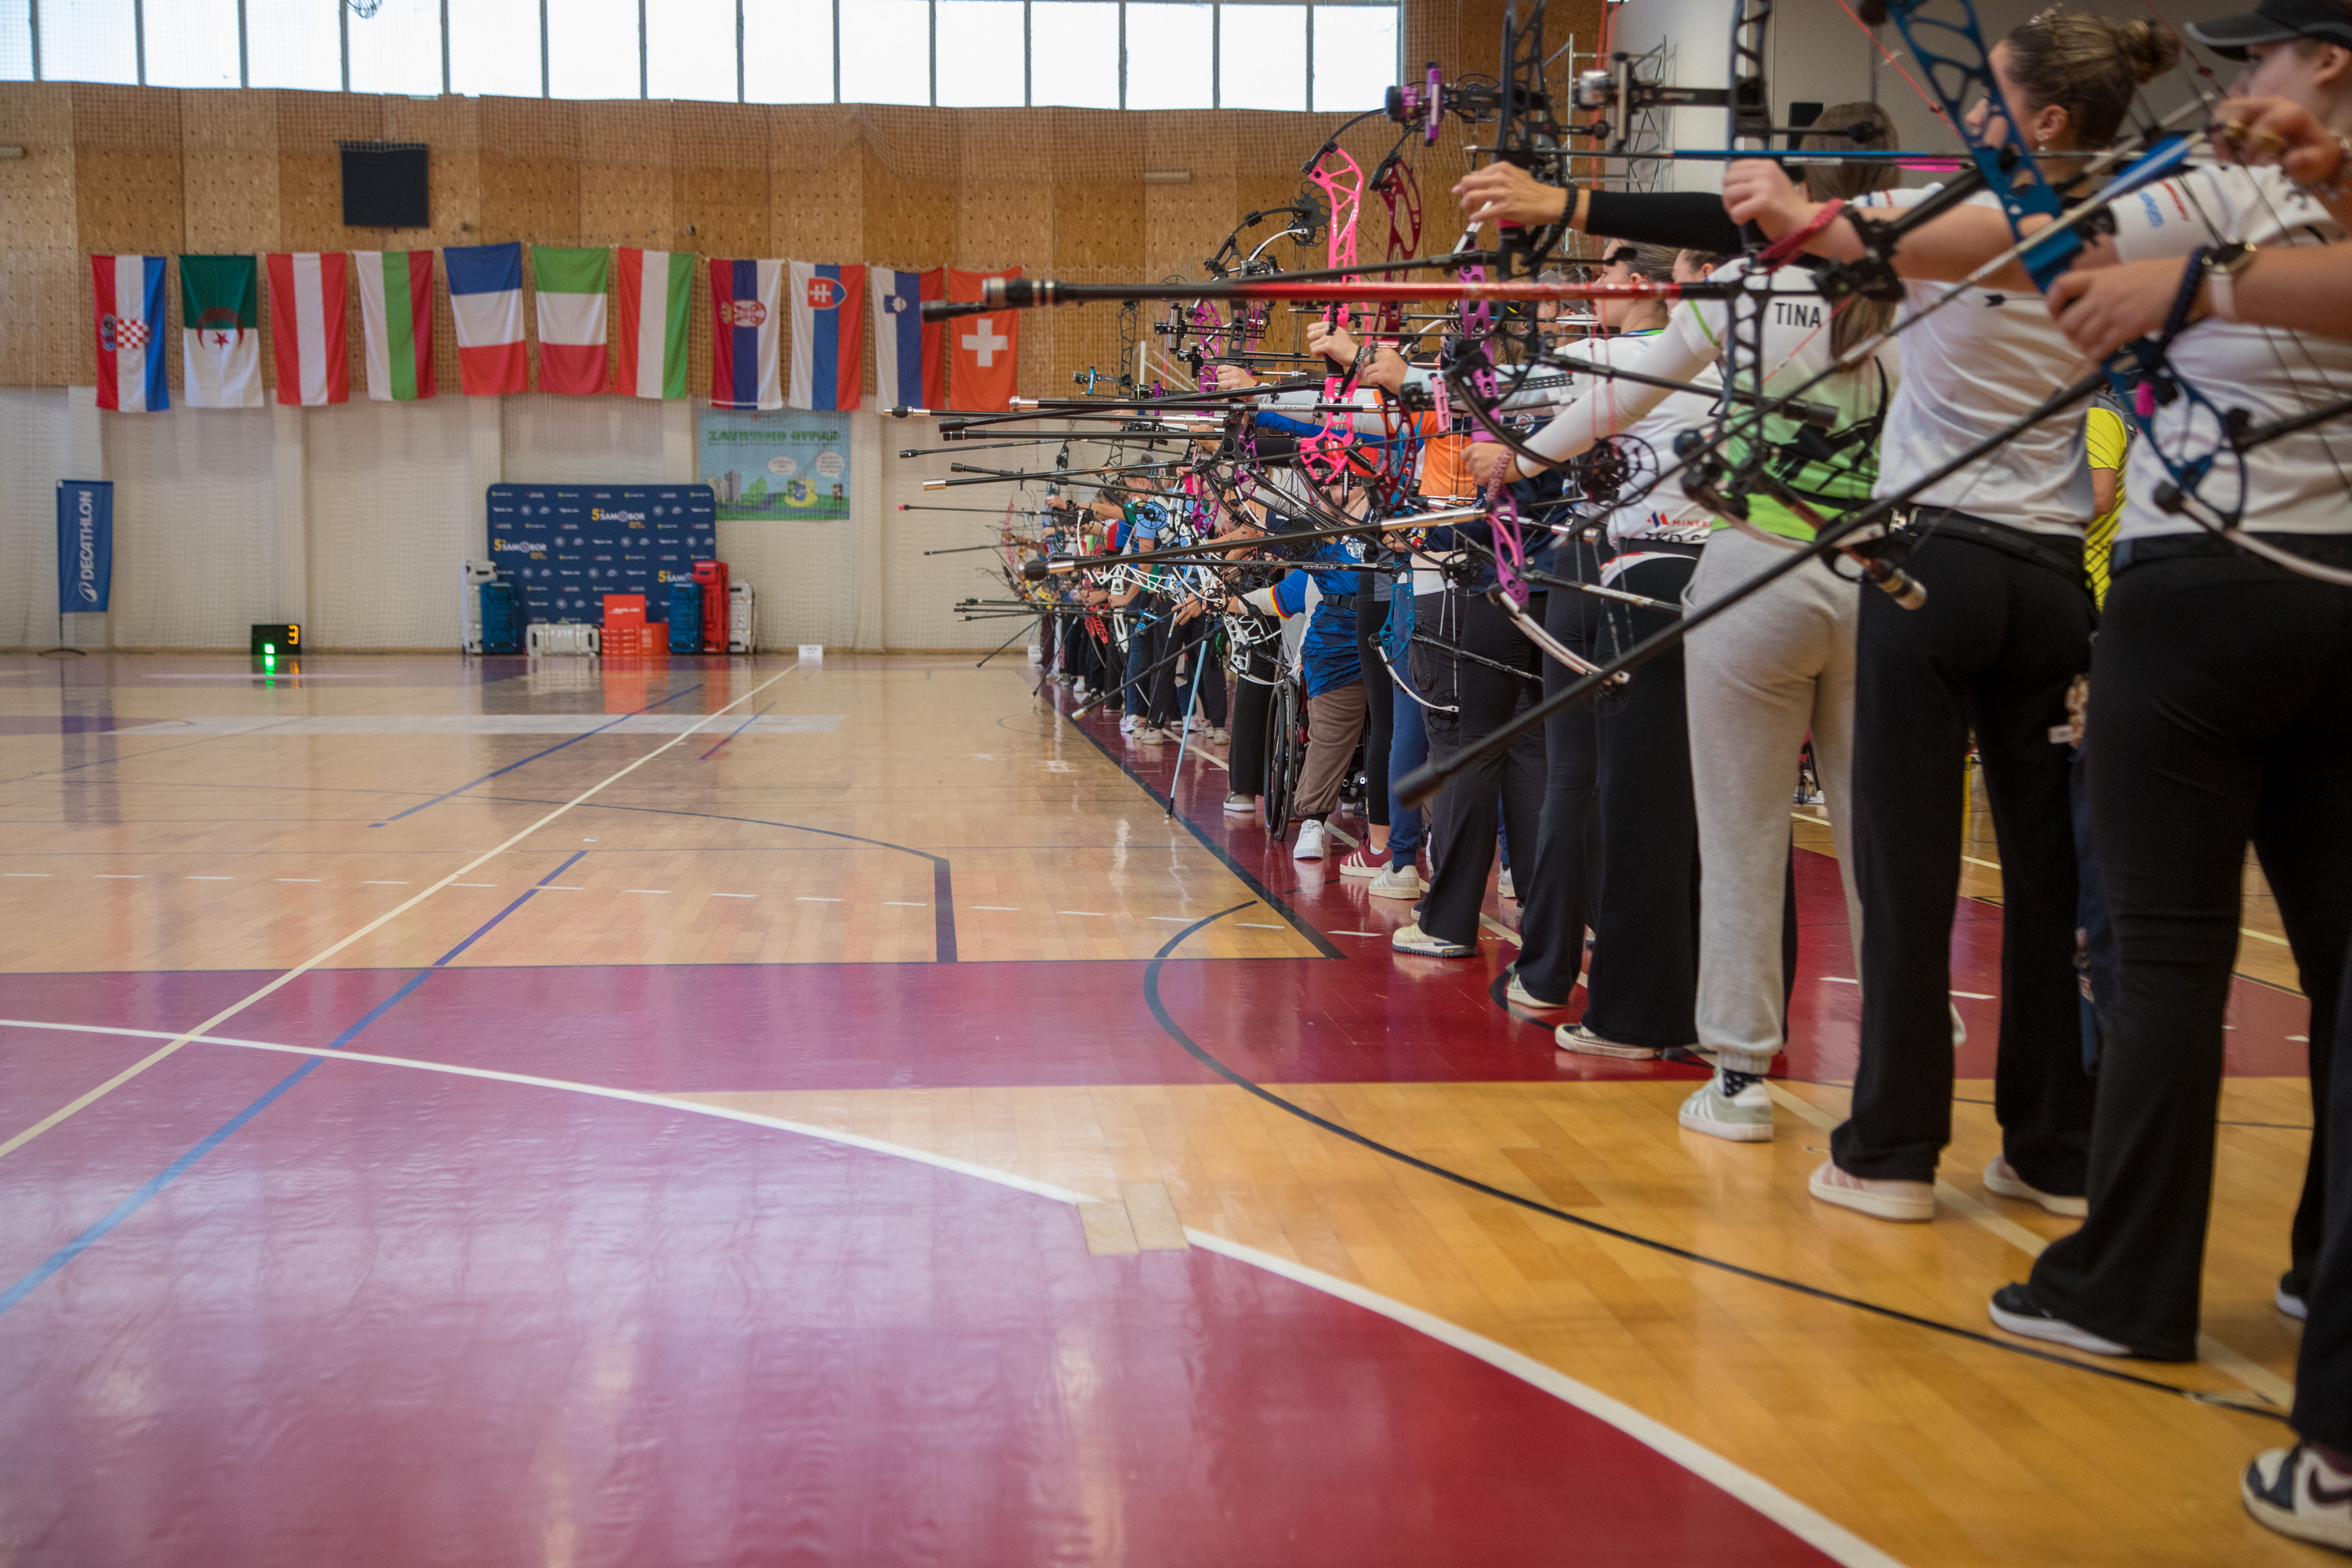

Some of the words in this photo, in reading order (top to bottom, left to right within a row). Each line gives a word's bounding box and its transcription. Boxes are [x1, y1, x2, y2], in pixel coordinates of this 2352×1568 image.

[1775, 302, 1821, 328] TINA
[600, 510, 645, 522] SAMOBOR
[79, 491, 95, 580] DECATHLON
[502, 541, 547, 553] SAMOBOR
[288, 624, 299, 644] 3
